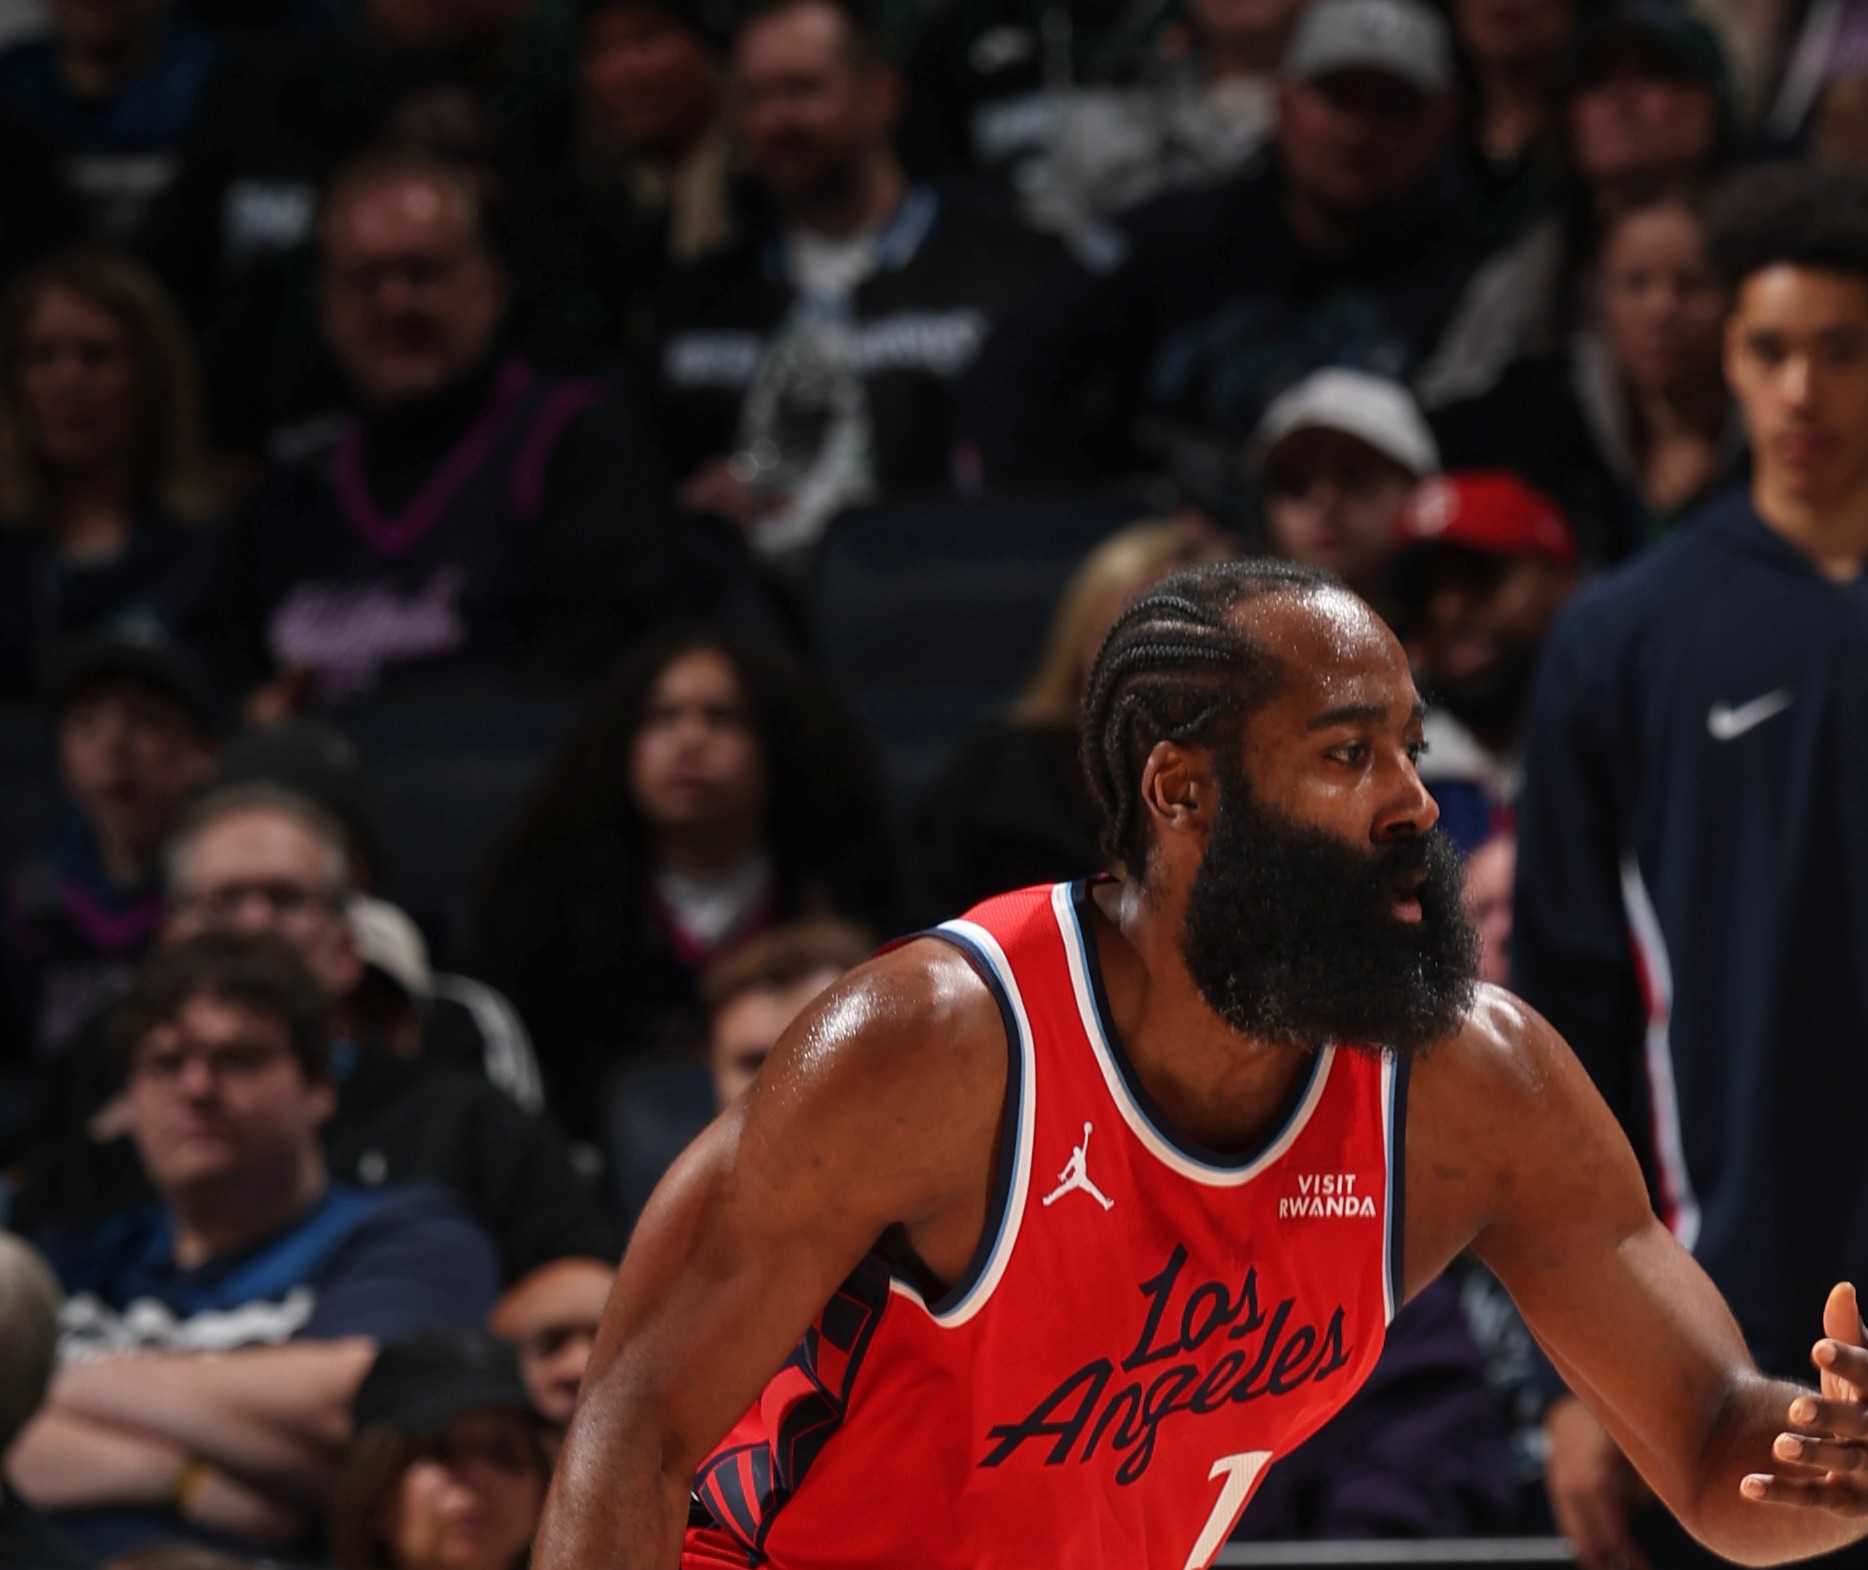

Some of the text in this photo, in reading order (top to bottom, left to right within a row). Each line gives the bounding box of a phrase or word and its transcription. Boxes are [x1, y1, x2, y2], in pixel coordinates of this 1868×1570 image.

[1279, 1195, 1377, 1219] RWANDA
[1298, 1173, 1356, 1196] VISIT
[1120, 1242, 1266, 1373] Los
[975, 1297, 1352, 1486] Angeles
